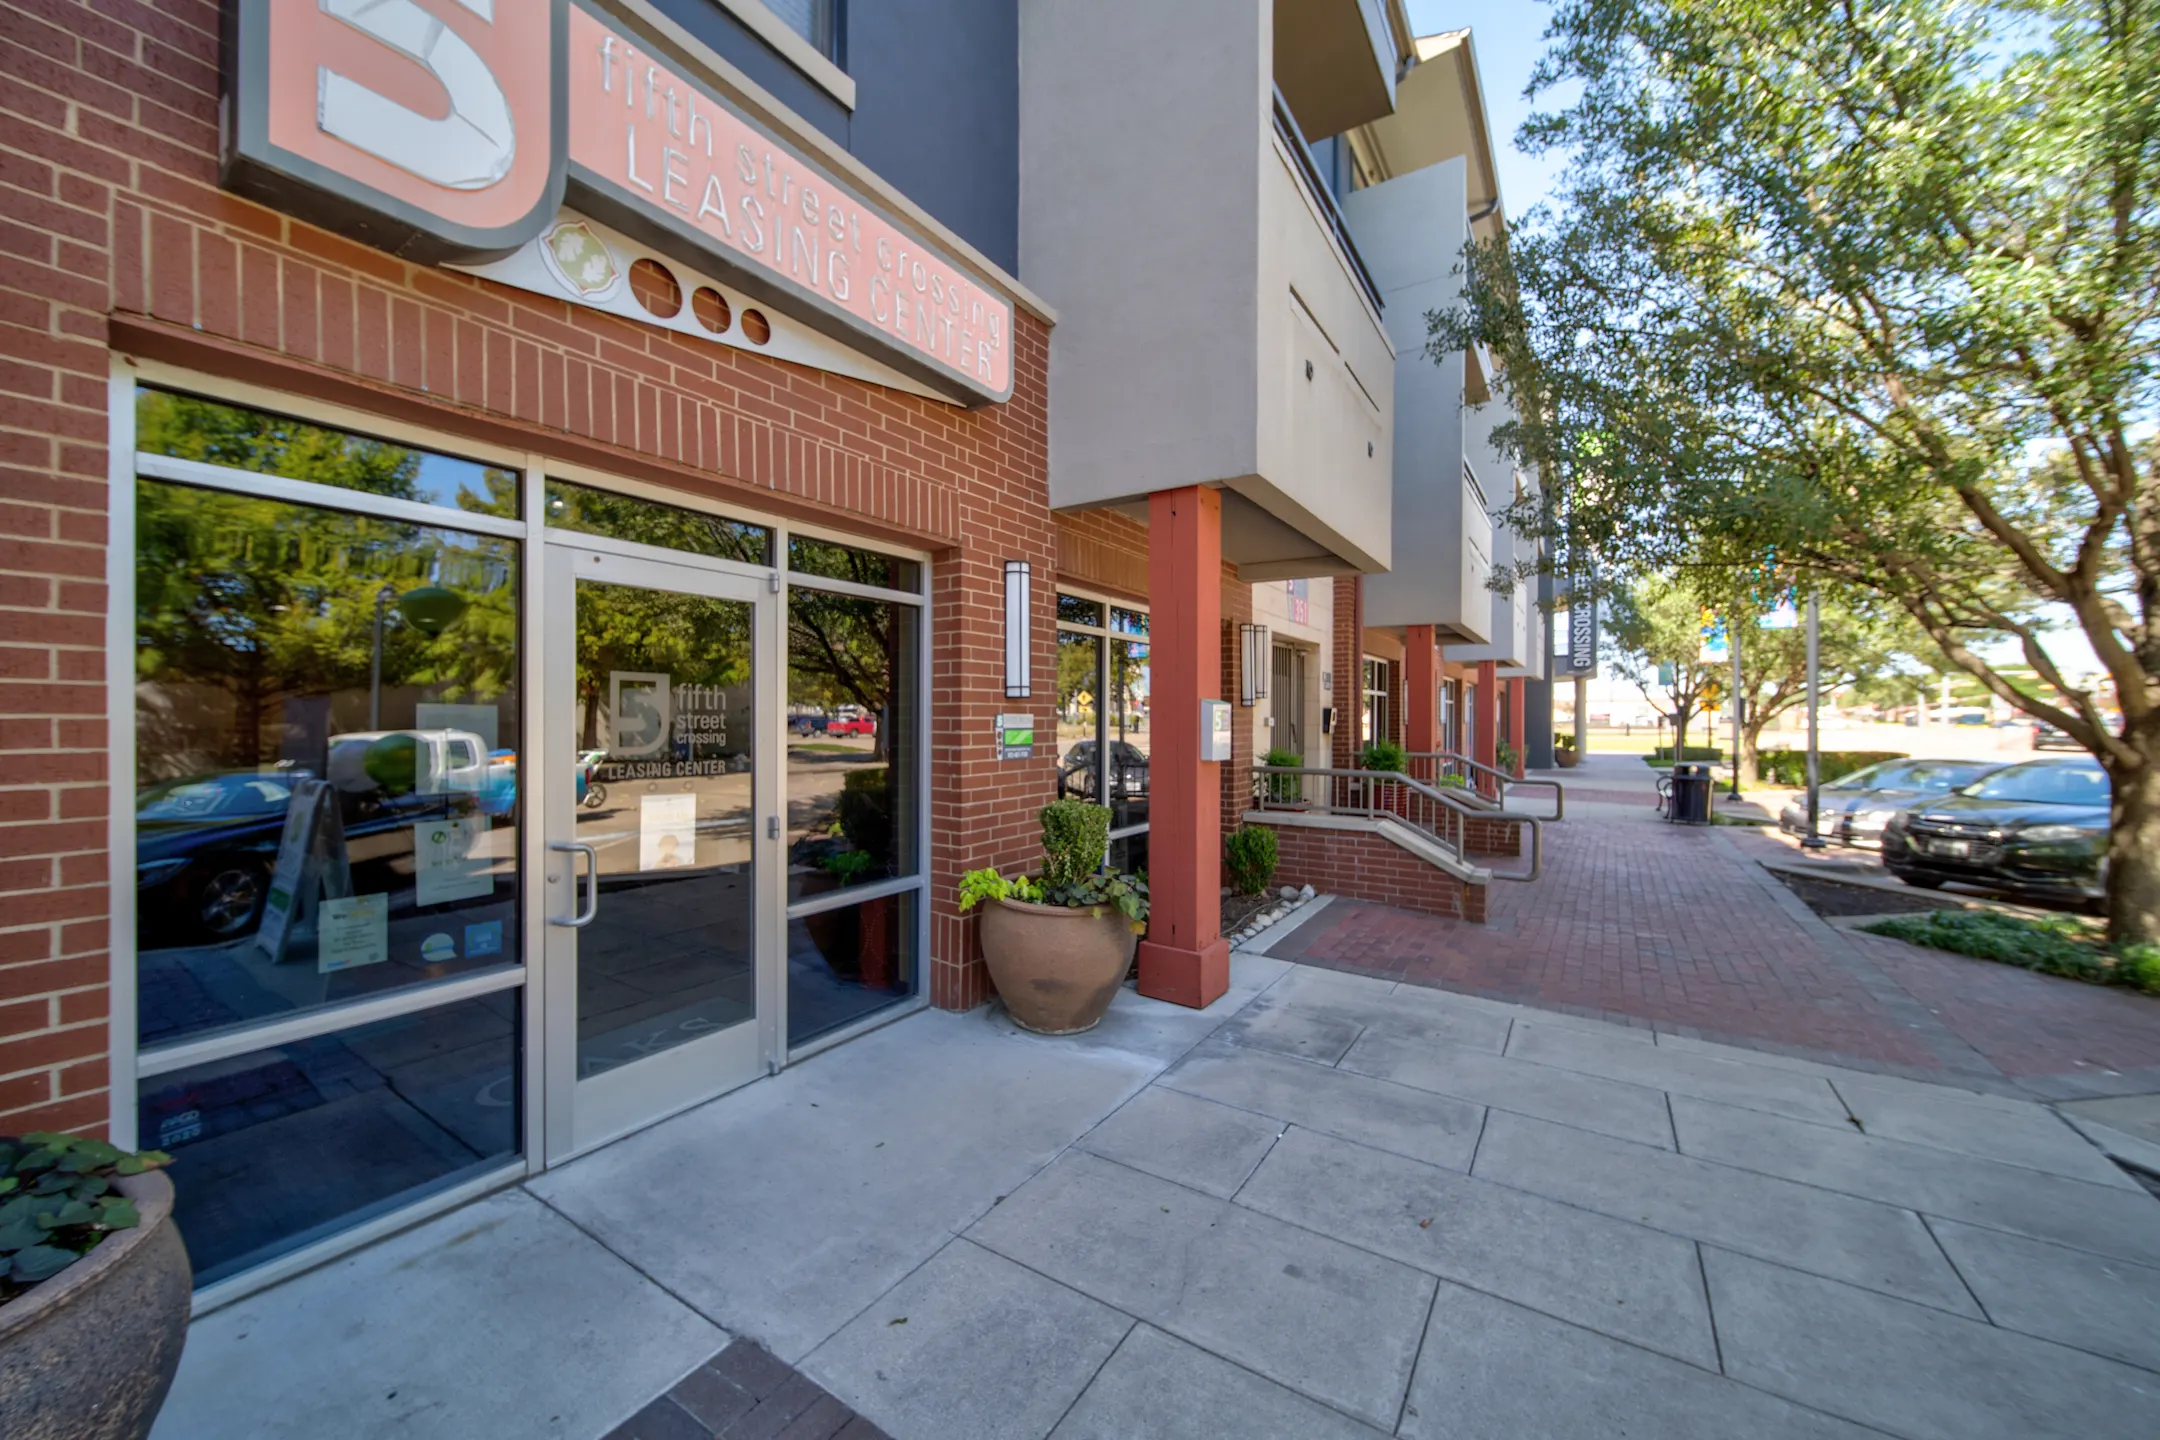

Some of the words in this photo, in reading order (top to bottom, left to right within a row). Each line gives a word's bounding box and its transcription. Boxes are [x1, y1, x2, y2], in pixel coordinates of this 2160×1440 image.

[316, 0, 516, 190] 5
[598, 36, 713, 158] fifth
[737, 143, 861, 253] street
[876, 237, 1000, 349] crossing
[627, 123, 850, 301] LEASING
[869, 276, 992, 382] CENTER
[1574, 601, 1592, 667] CROSSING
[677, 683, 727, 711] fifth
[677, 712, 727, 730] street
[677, 729, 727, 747] crossing
[608, 761, 671, 780] LEASING
[676, 760, 726, 777] CENTER
